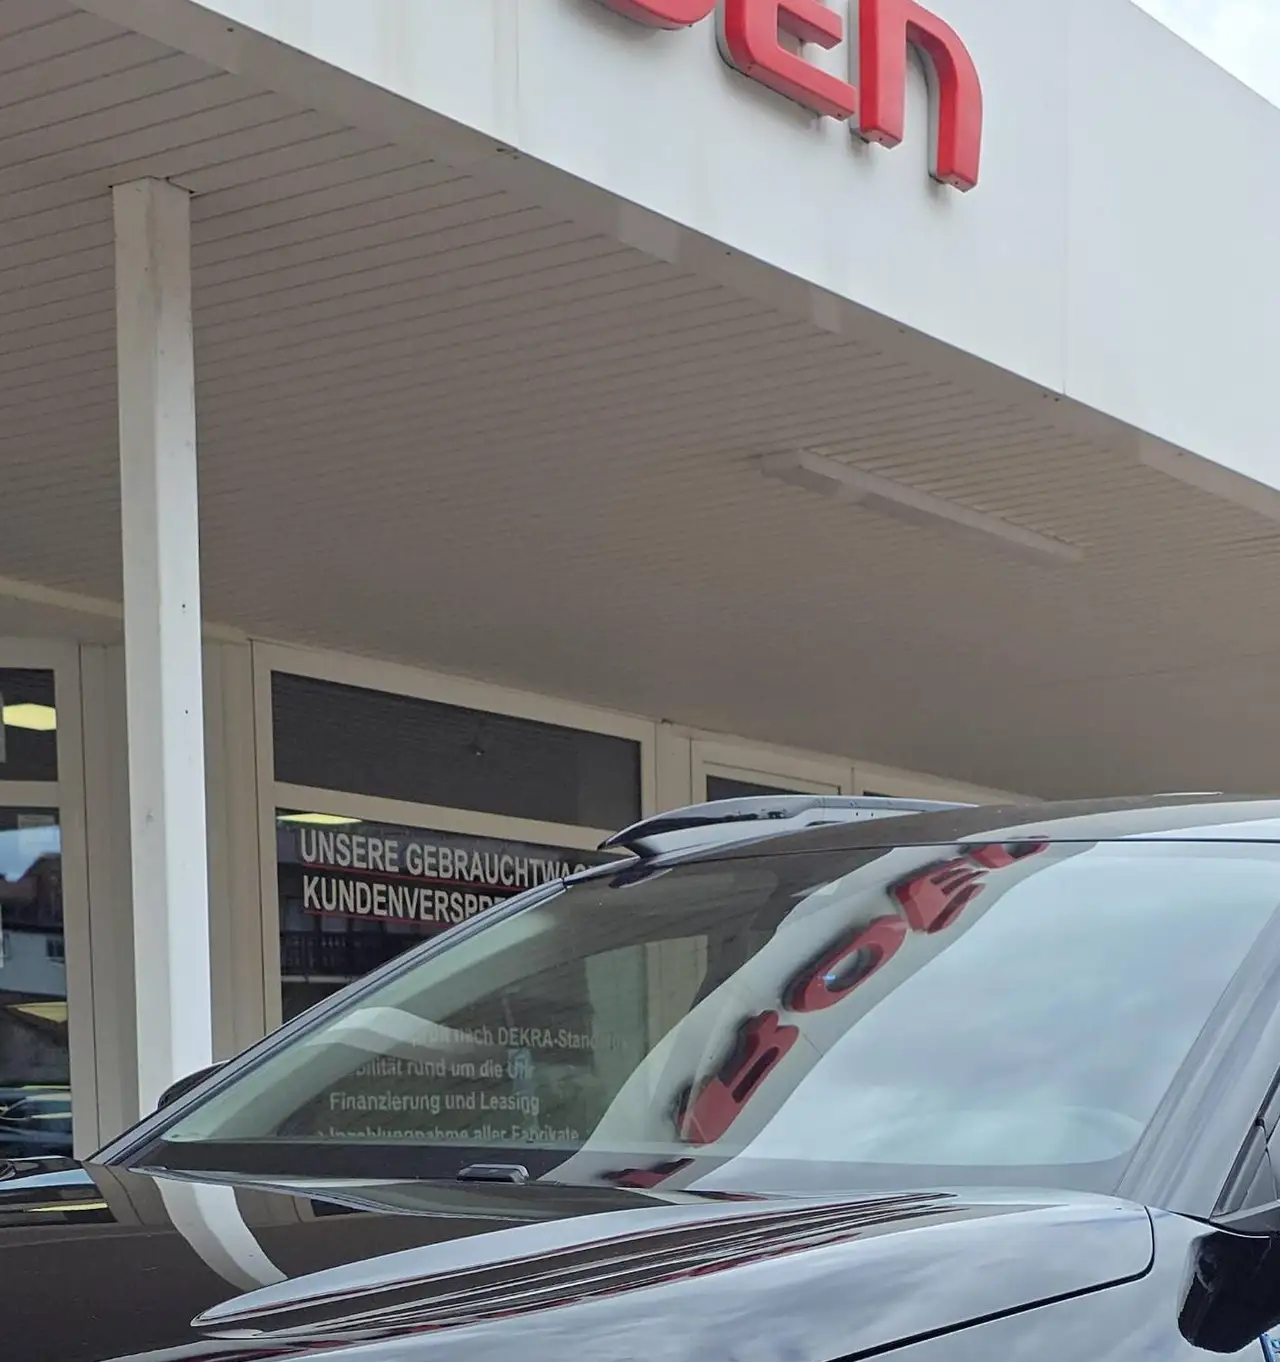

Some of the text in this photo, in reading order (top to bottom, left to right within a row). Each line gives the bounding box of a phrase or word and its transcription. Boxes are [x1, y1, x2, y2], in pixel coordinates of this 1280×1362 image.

[300, 828, 399, 872] UNSERE
[407, 1058, 447, 1078] rund
[451, 1062, 476, 1078] um
[480, 1058, 504, 1079] die
[329, 1090, 540, 1116] Finanzierung und Leasing
